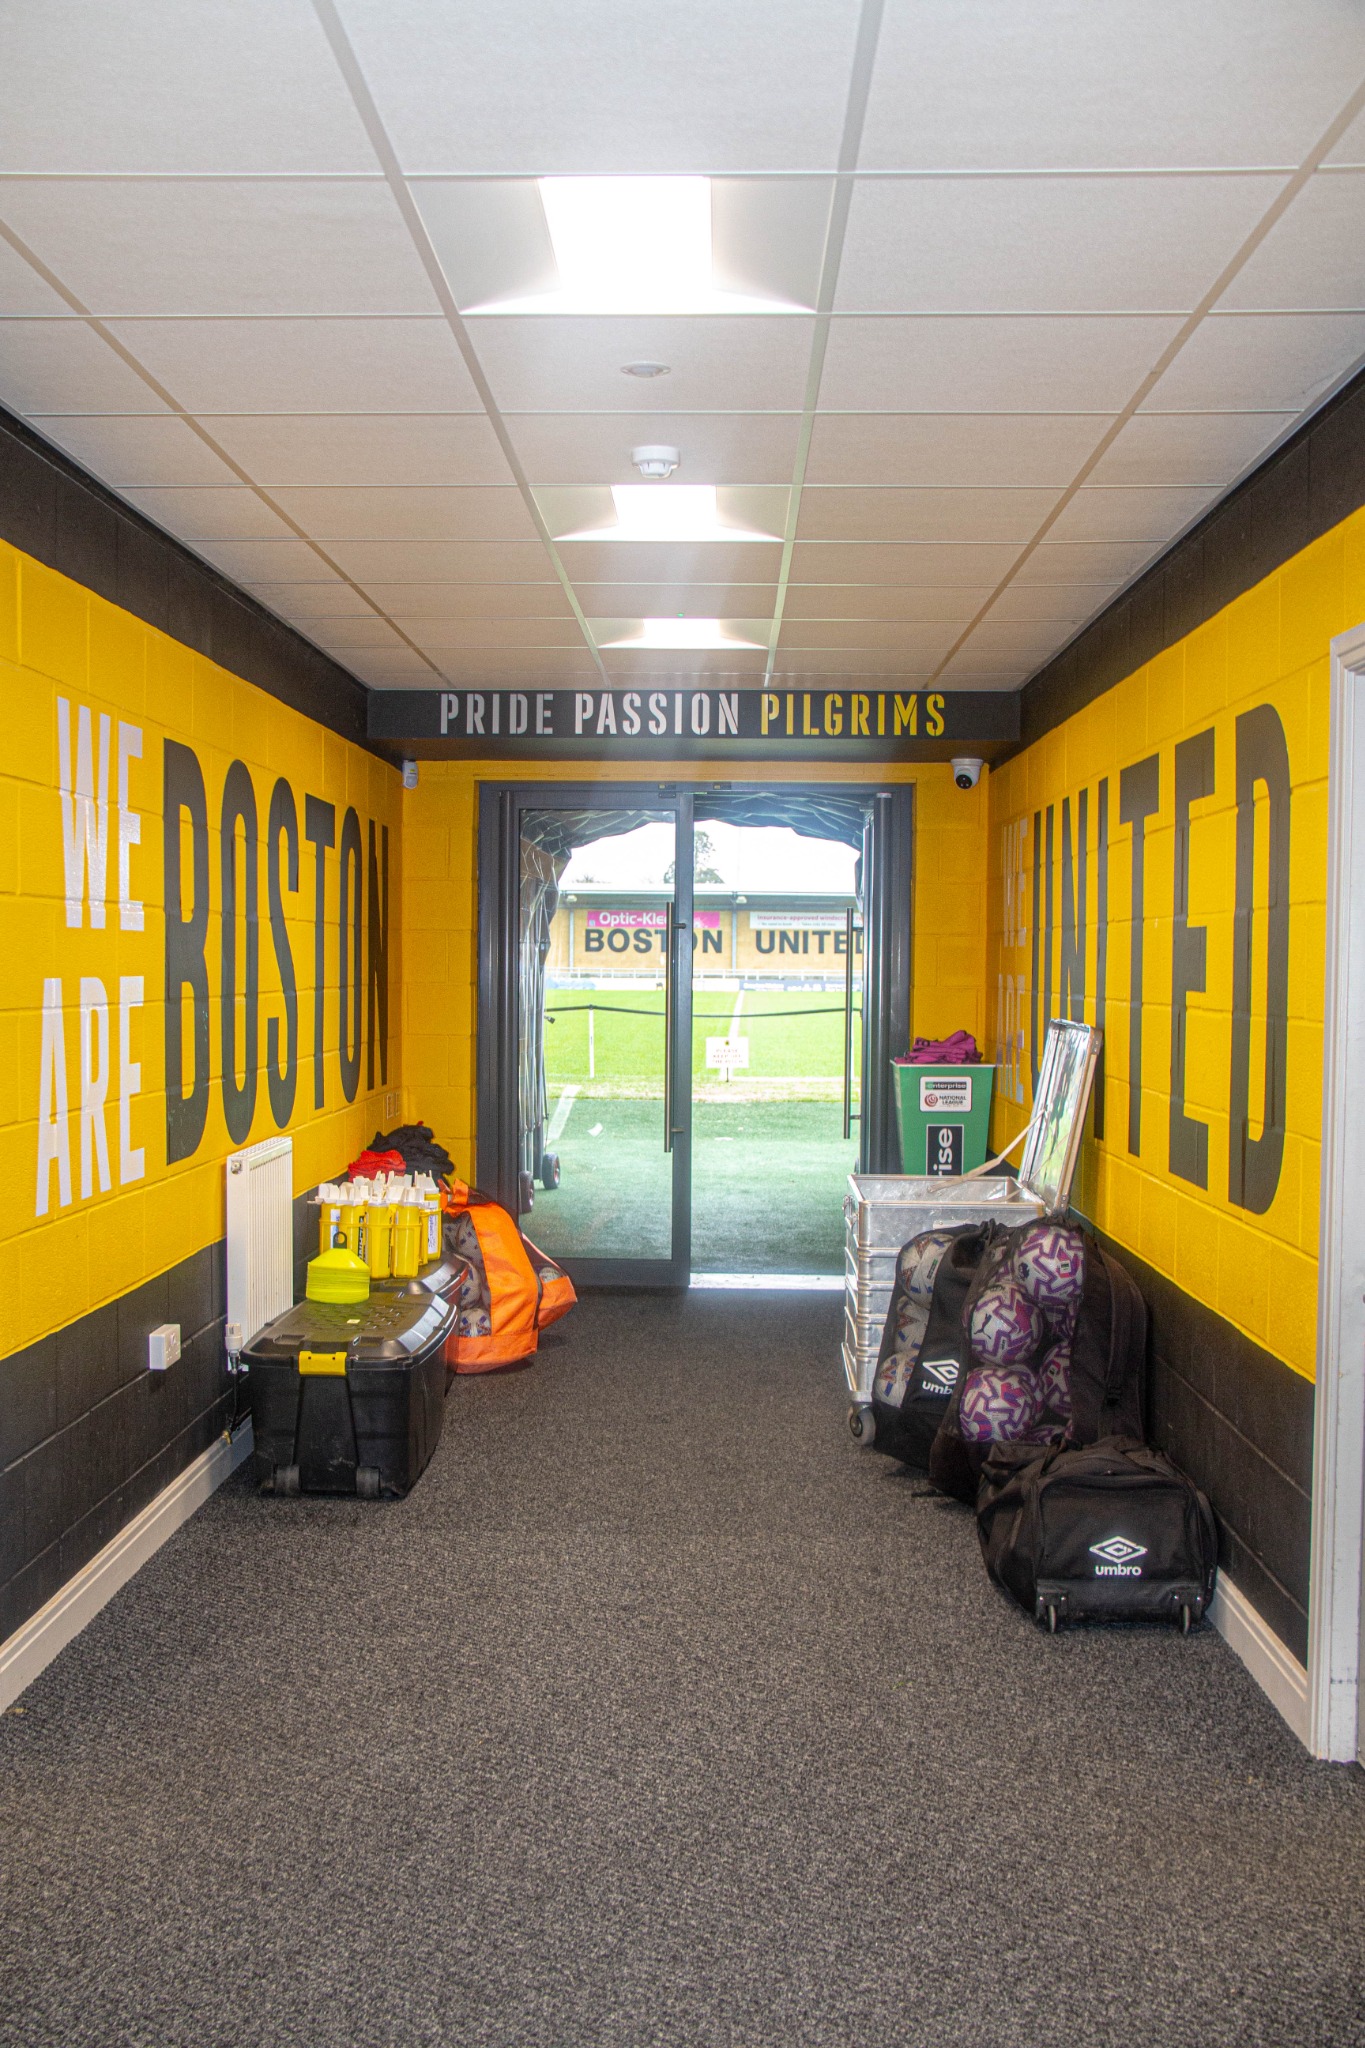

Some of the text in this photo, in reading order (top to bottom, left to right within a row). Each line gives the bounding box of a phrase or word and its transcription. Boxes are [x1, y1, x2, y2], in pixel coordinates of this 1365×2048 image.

[440, 692, 946, 738] PRIDE PASSION PILGRIMS
[56, 696, 146, 932] WE
[163, 737, 390, 1166] BOSTON
[585, 928, 723, 954] BOSTN
[1031, 702, 1291, 1216] UNITED
[35, 975, 146, 1217] ARE
[925, 1082, 967, 1090] enterprise
[921, 1380, 954, 1395] umb
[1095, 1564, 1142, 1576] umbro
